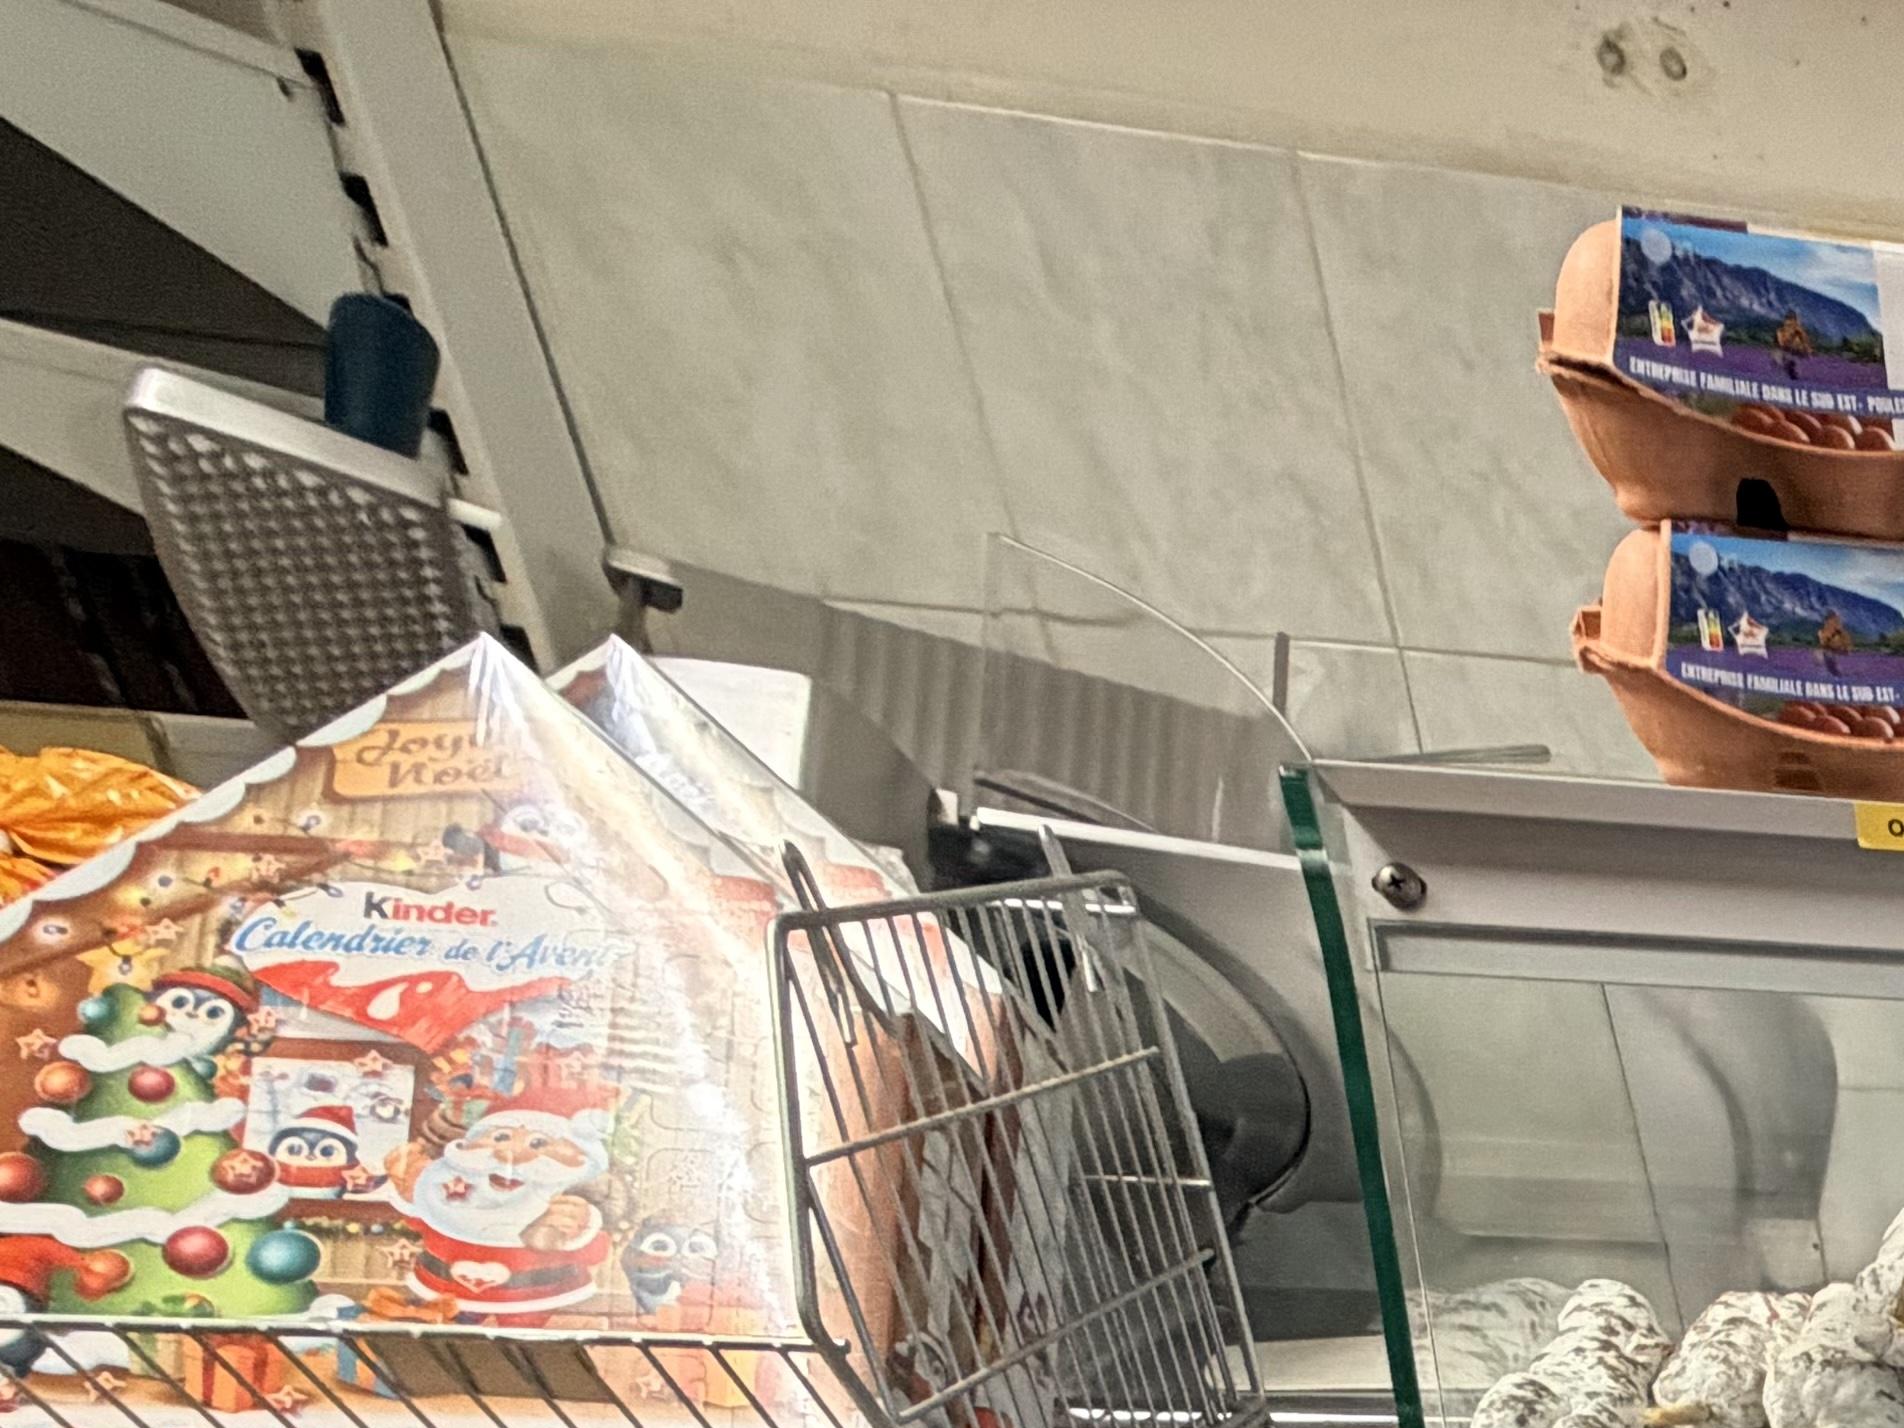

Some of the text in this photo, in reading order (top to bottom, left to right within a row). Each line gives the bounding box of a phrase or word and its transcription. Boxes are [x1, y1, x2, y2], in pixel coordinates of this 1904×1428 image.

[364, 892, 494, 927] Kinder
[235, 917, 432, 957] Calendrier
[445, 938, 477, 962] de
